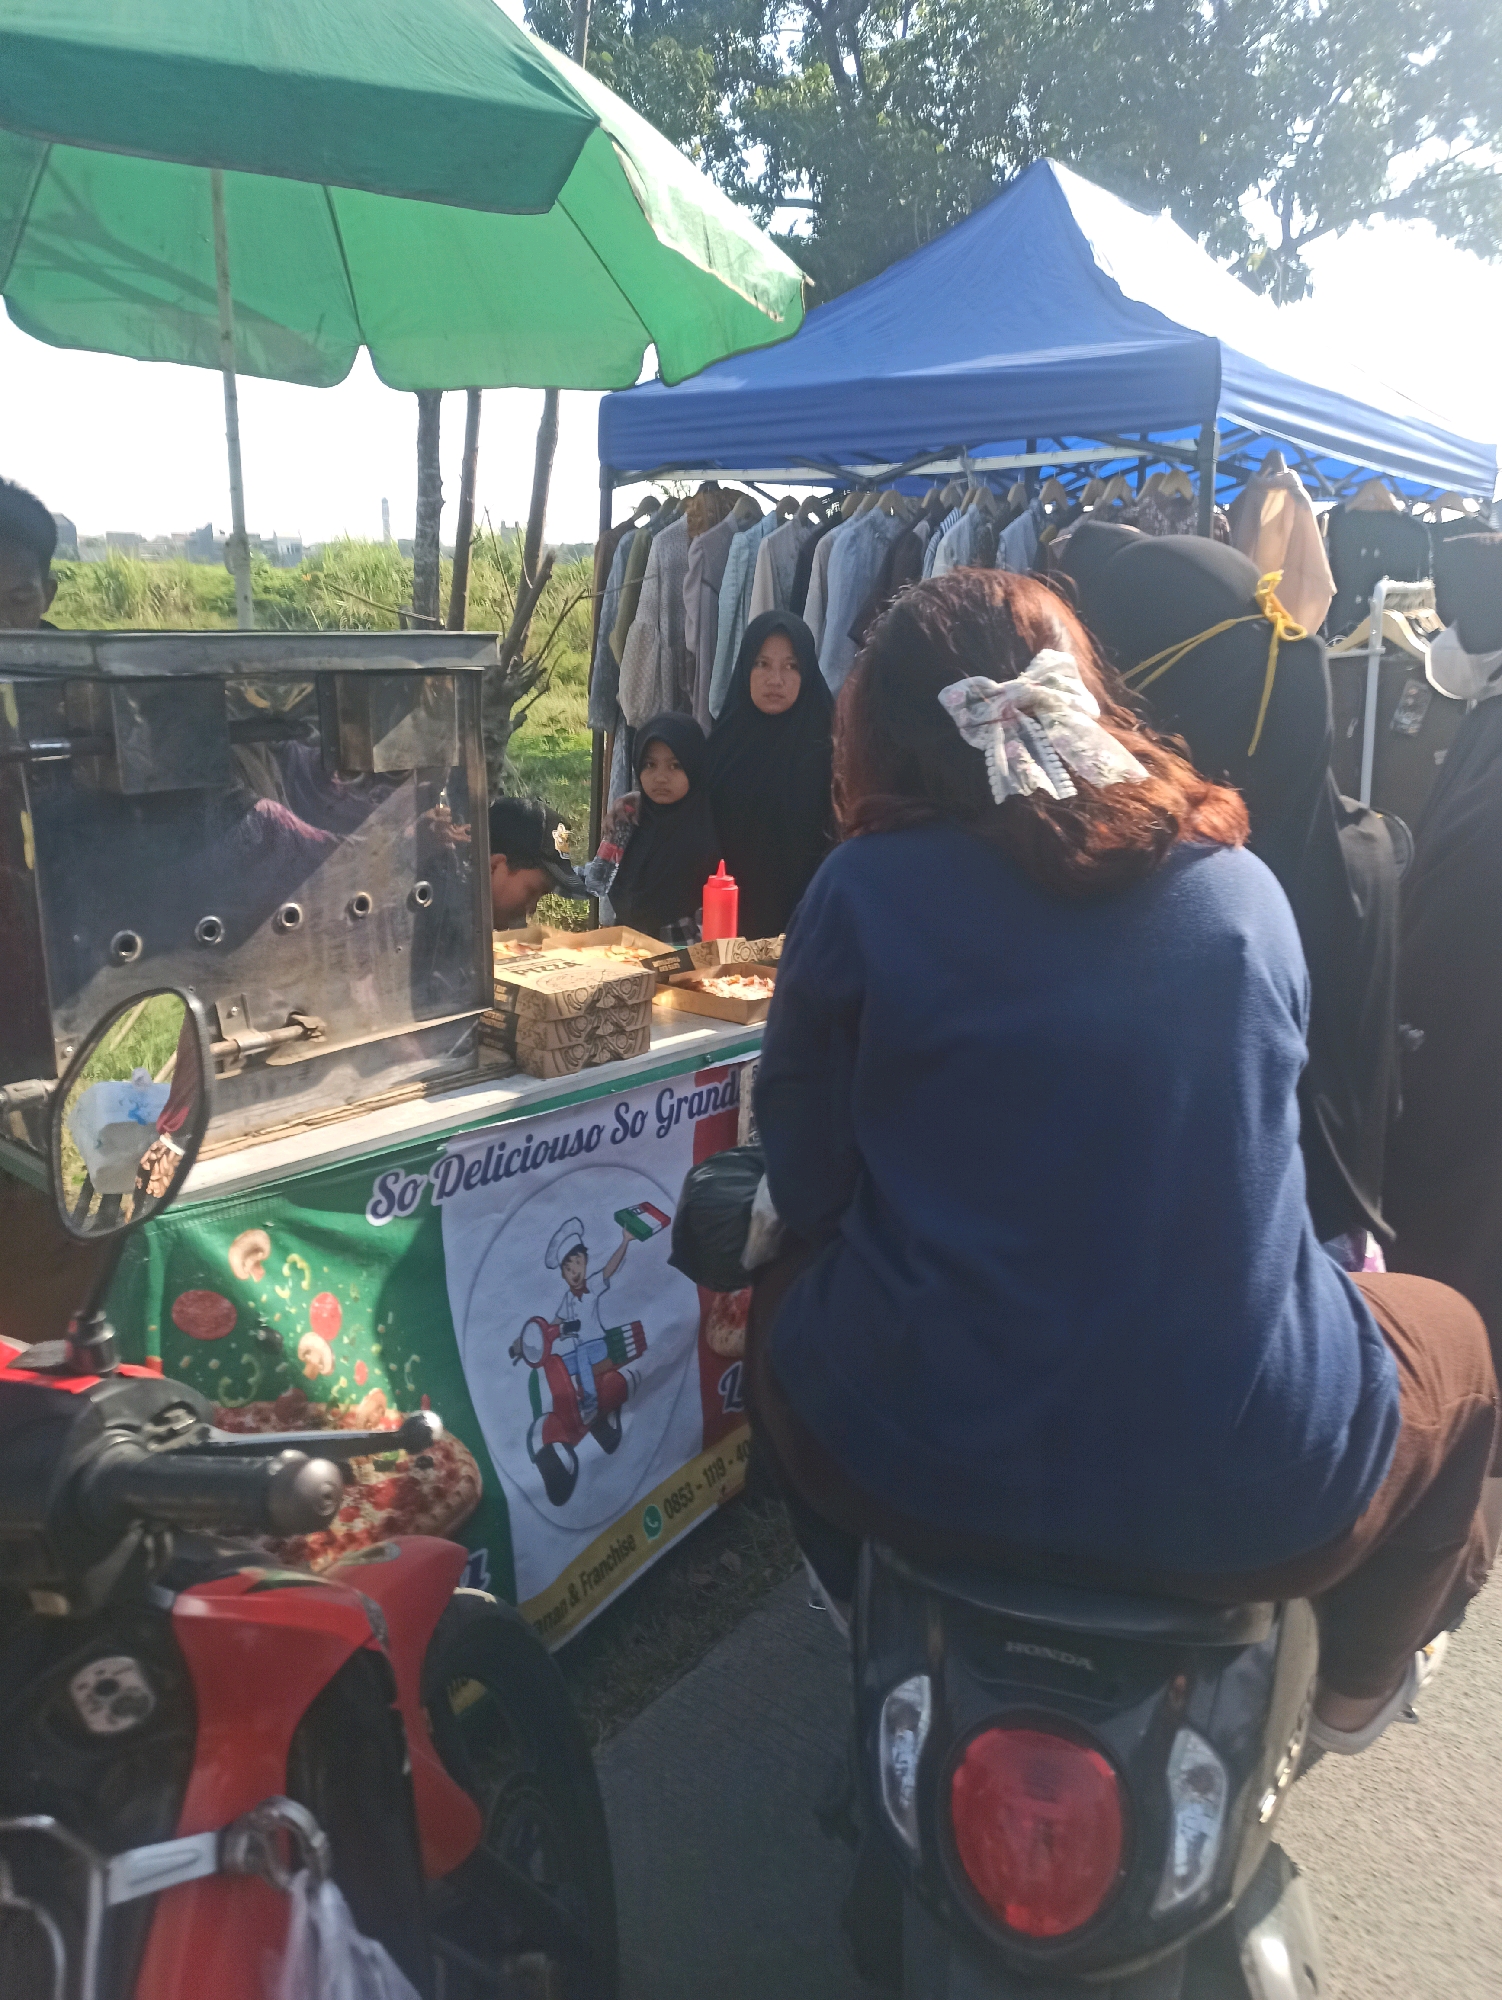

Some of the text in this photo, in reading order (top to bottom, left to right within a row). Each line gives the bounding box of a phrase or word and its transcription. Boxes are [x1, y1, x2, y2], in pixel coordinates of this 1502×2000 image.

[370, 1071, 740, 1219] So Deliciouso So Grand
[567, 1582, 580, 1607] &
[579, 1533, 636, 1596] Franchise
[663, 1481, 694, 1519] 0853
[1005, 1641, 1094, 1671] HONDA
